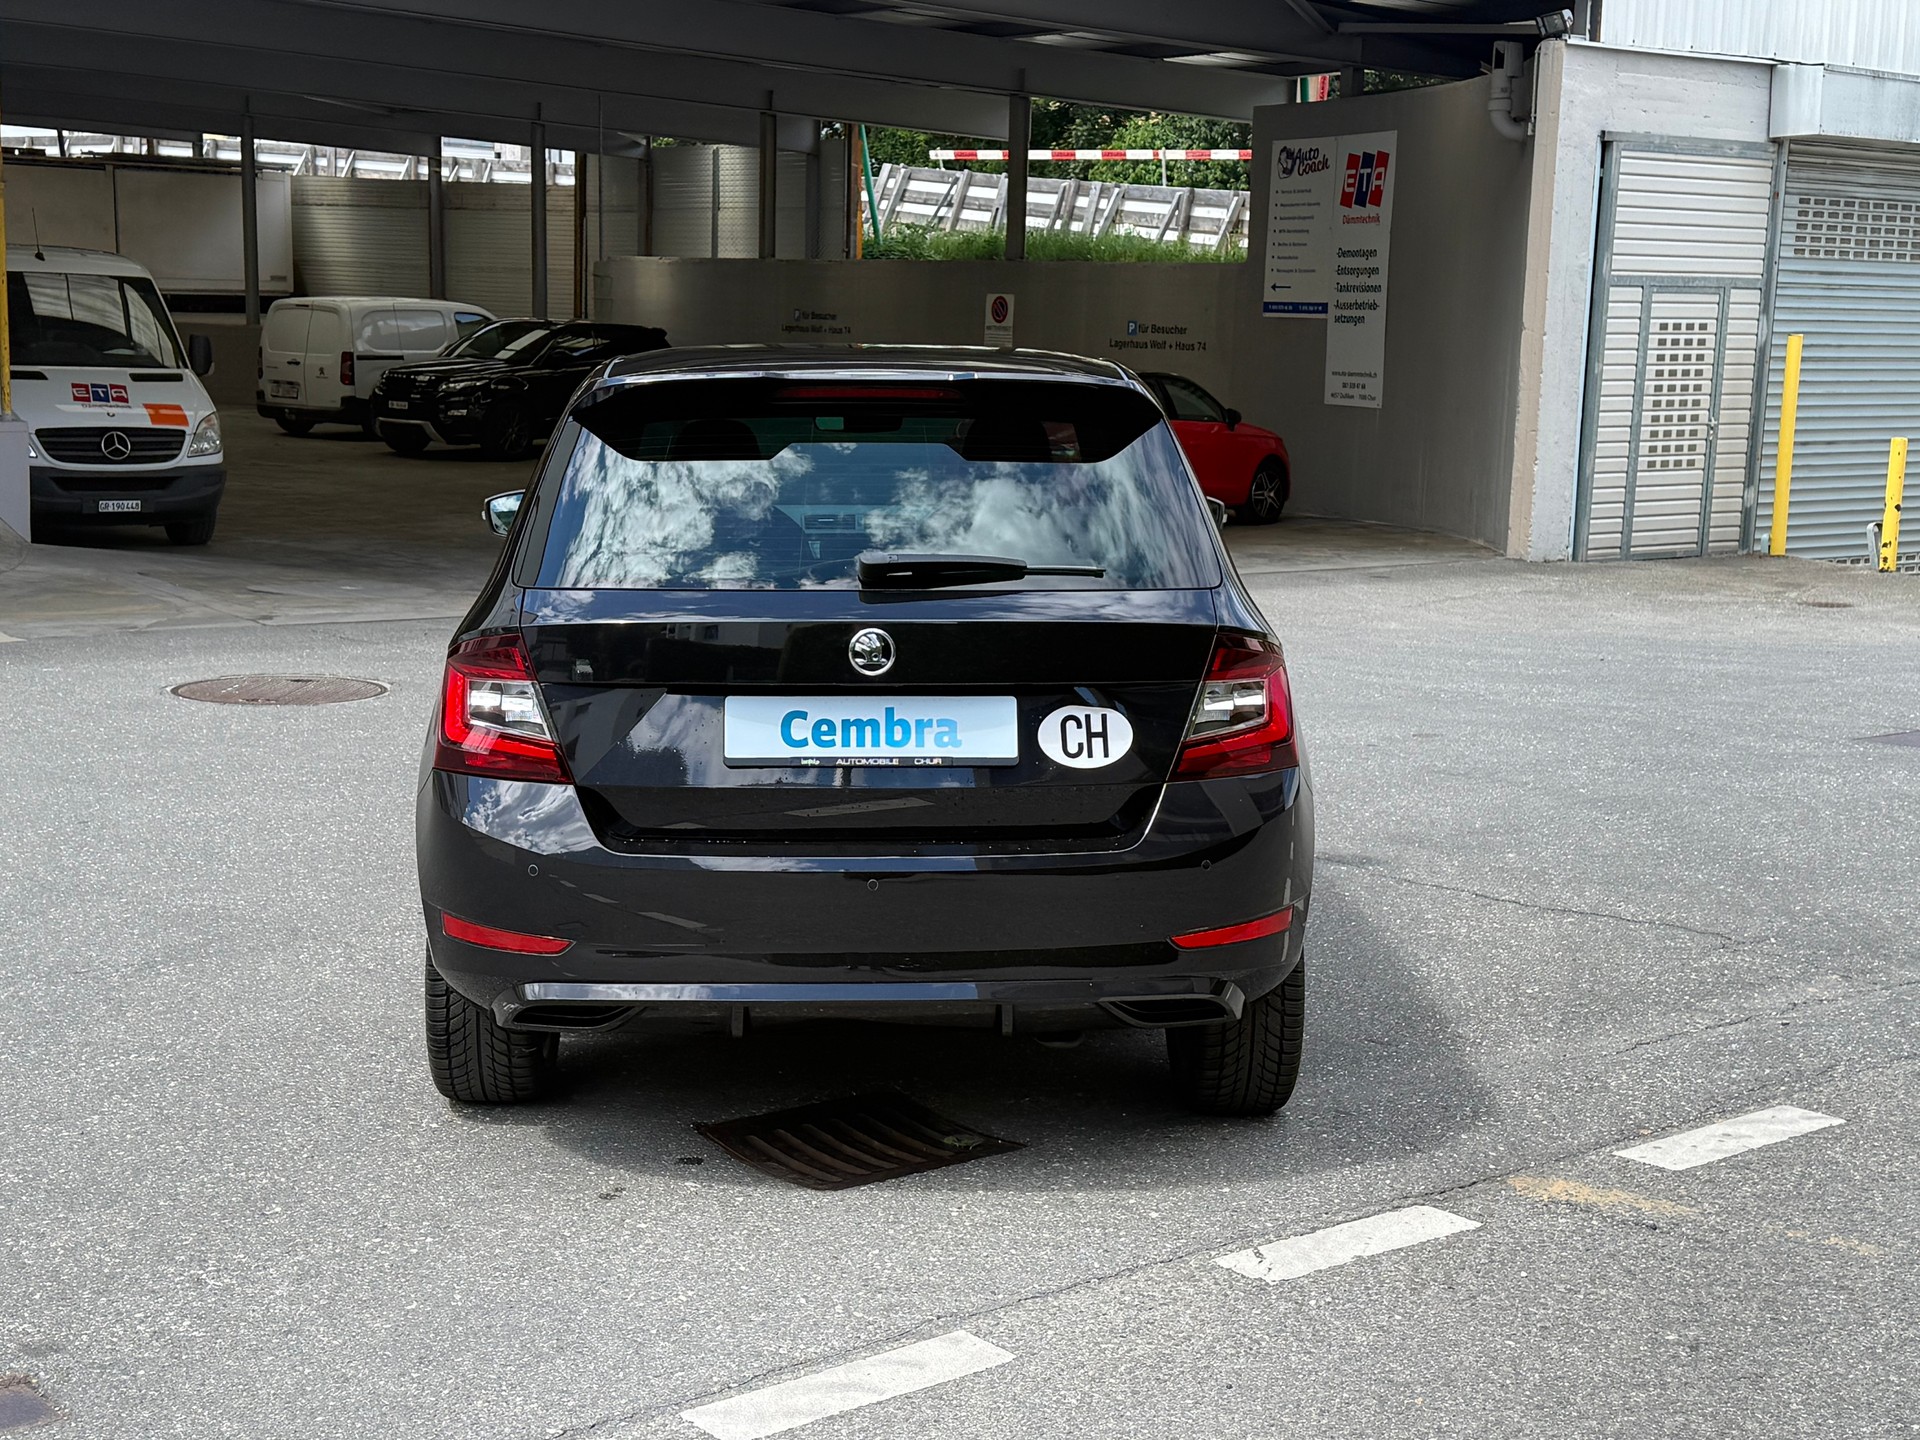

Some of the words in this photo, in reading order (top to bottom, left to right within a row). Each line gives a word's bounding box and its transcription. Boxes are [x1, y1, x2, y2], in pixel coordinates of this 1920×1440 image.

[1295, 147, 1320, 164] Auto
[1297, 154, 1330, 176] Coach
[1344, 166, 1386, 193] ETA
[1334, 313, 1366, 326] setzungen
[1138, 323, 1149, 334] für
[1150, 324, 1187, 335] Besucher
[1109, 338, 1148, 350] Lagerhaus
[1175, 341, 1195, 351] Haus
[1197, 341, 1207, 351] 74
[72, 387, 128, 399] ETA
[780, 707, 962, 749] Cembra
[1060, 714, 1110, 759] CH
[835, 757, 900, 766] AUTOMOBILE
[913, 757, 942, 766] CHUR
